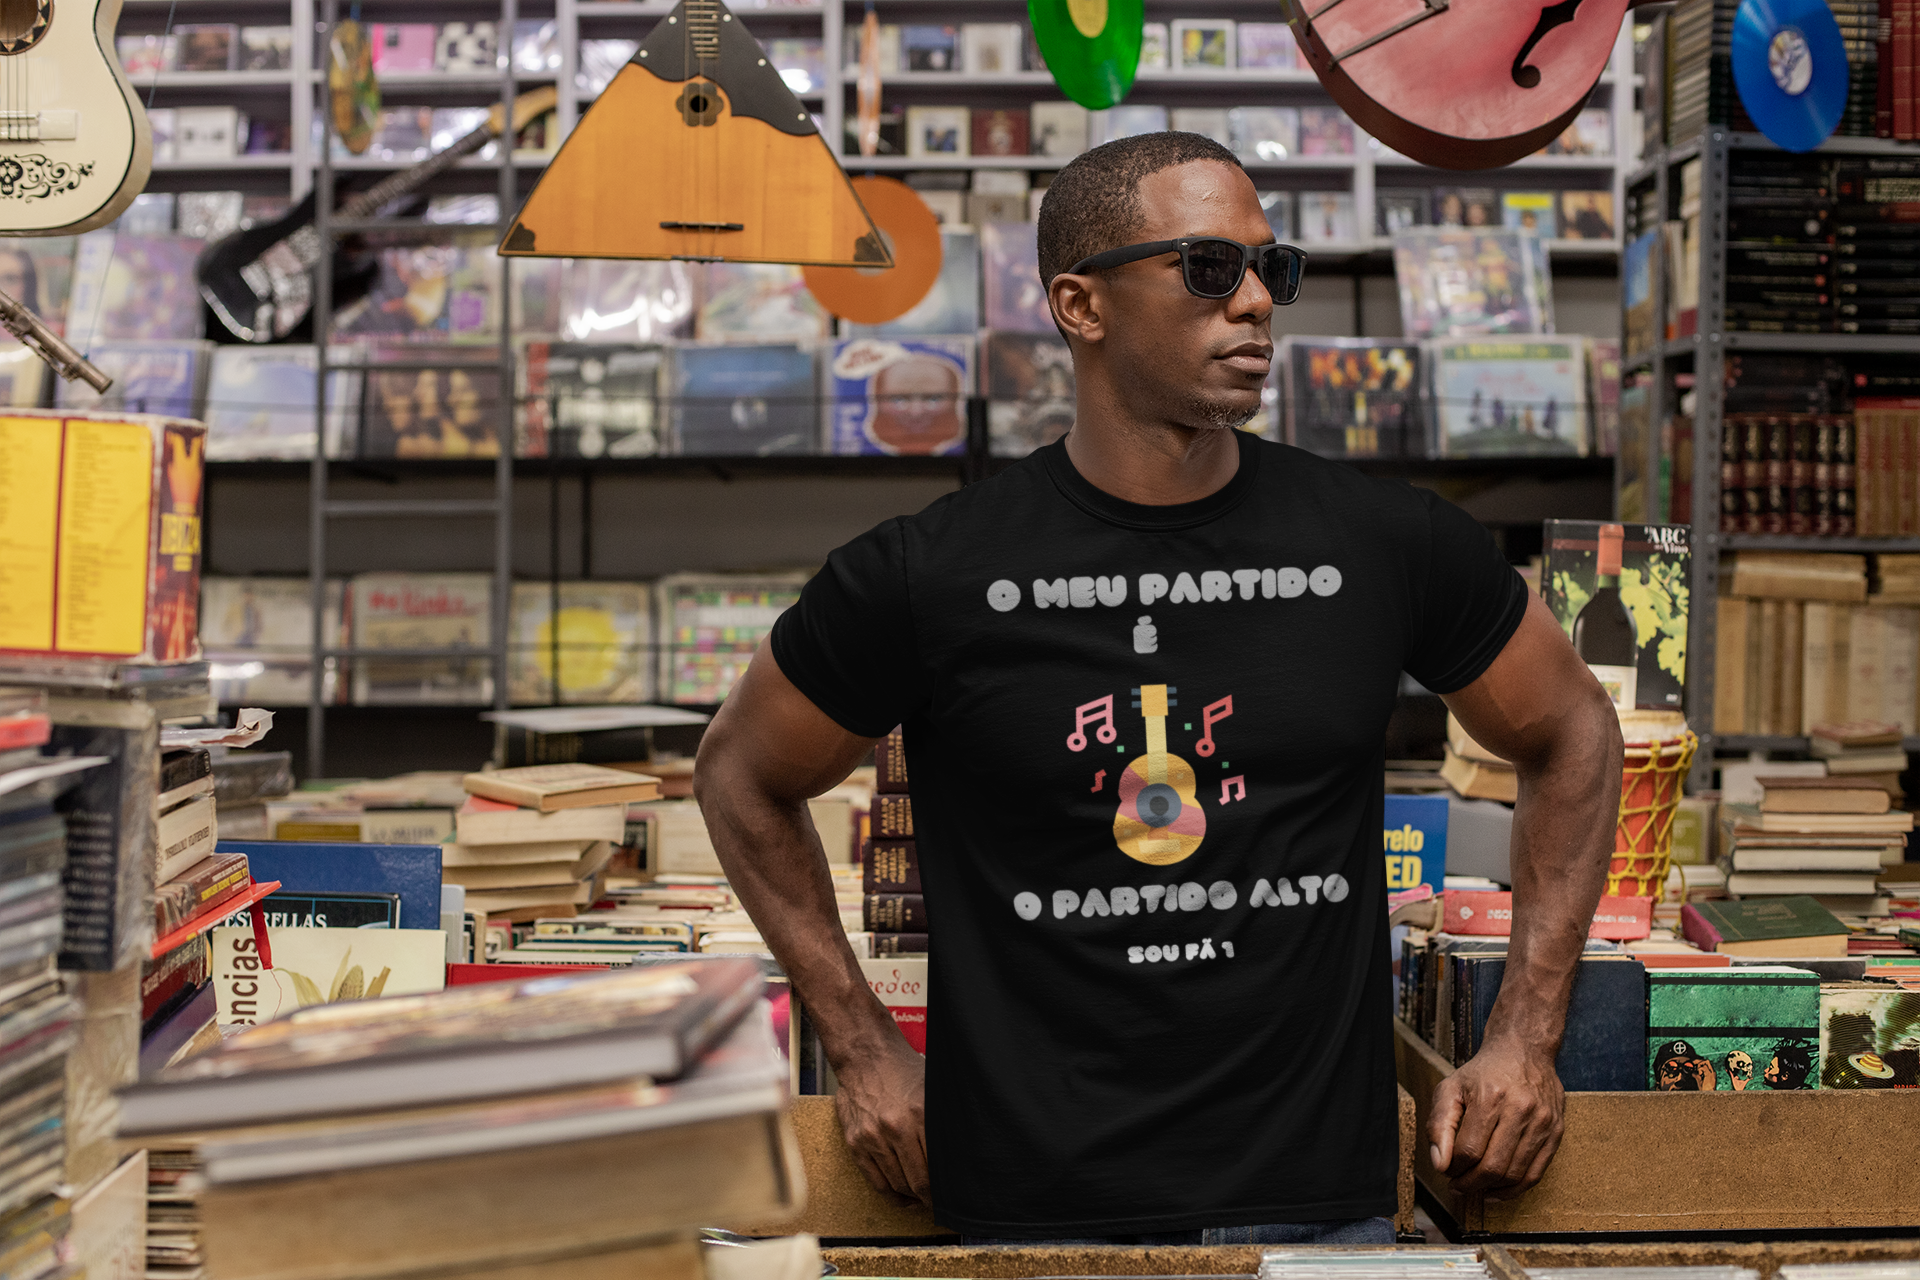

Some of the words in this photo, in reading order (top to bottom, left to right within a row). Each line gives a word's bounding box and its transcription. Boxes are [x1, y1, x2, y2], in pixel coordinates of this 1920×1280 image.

[1647, 527, 1686, 545] ABC
[1663, 542, 1689, 553] Vino
[987, 579, 1021, 612] O
[1032, 574, 1127, 609] MEU
[1139, 565, 1342, 605] PARTIDO
[1385, 855, 1422, 889] ED
[1013, 891, 1042, 921] O
[1052, 881, 1238, 919] PARTIDO
[1250, 873, 1350, 908] ALTO
[1487, 909, 1513, 920] INSO
[1618, 915, 1637, 923] KING
[1127, 944, 1180, 964] SOU
[1221, 941, 1235, 959] 1
